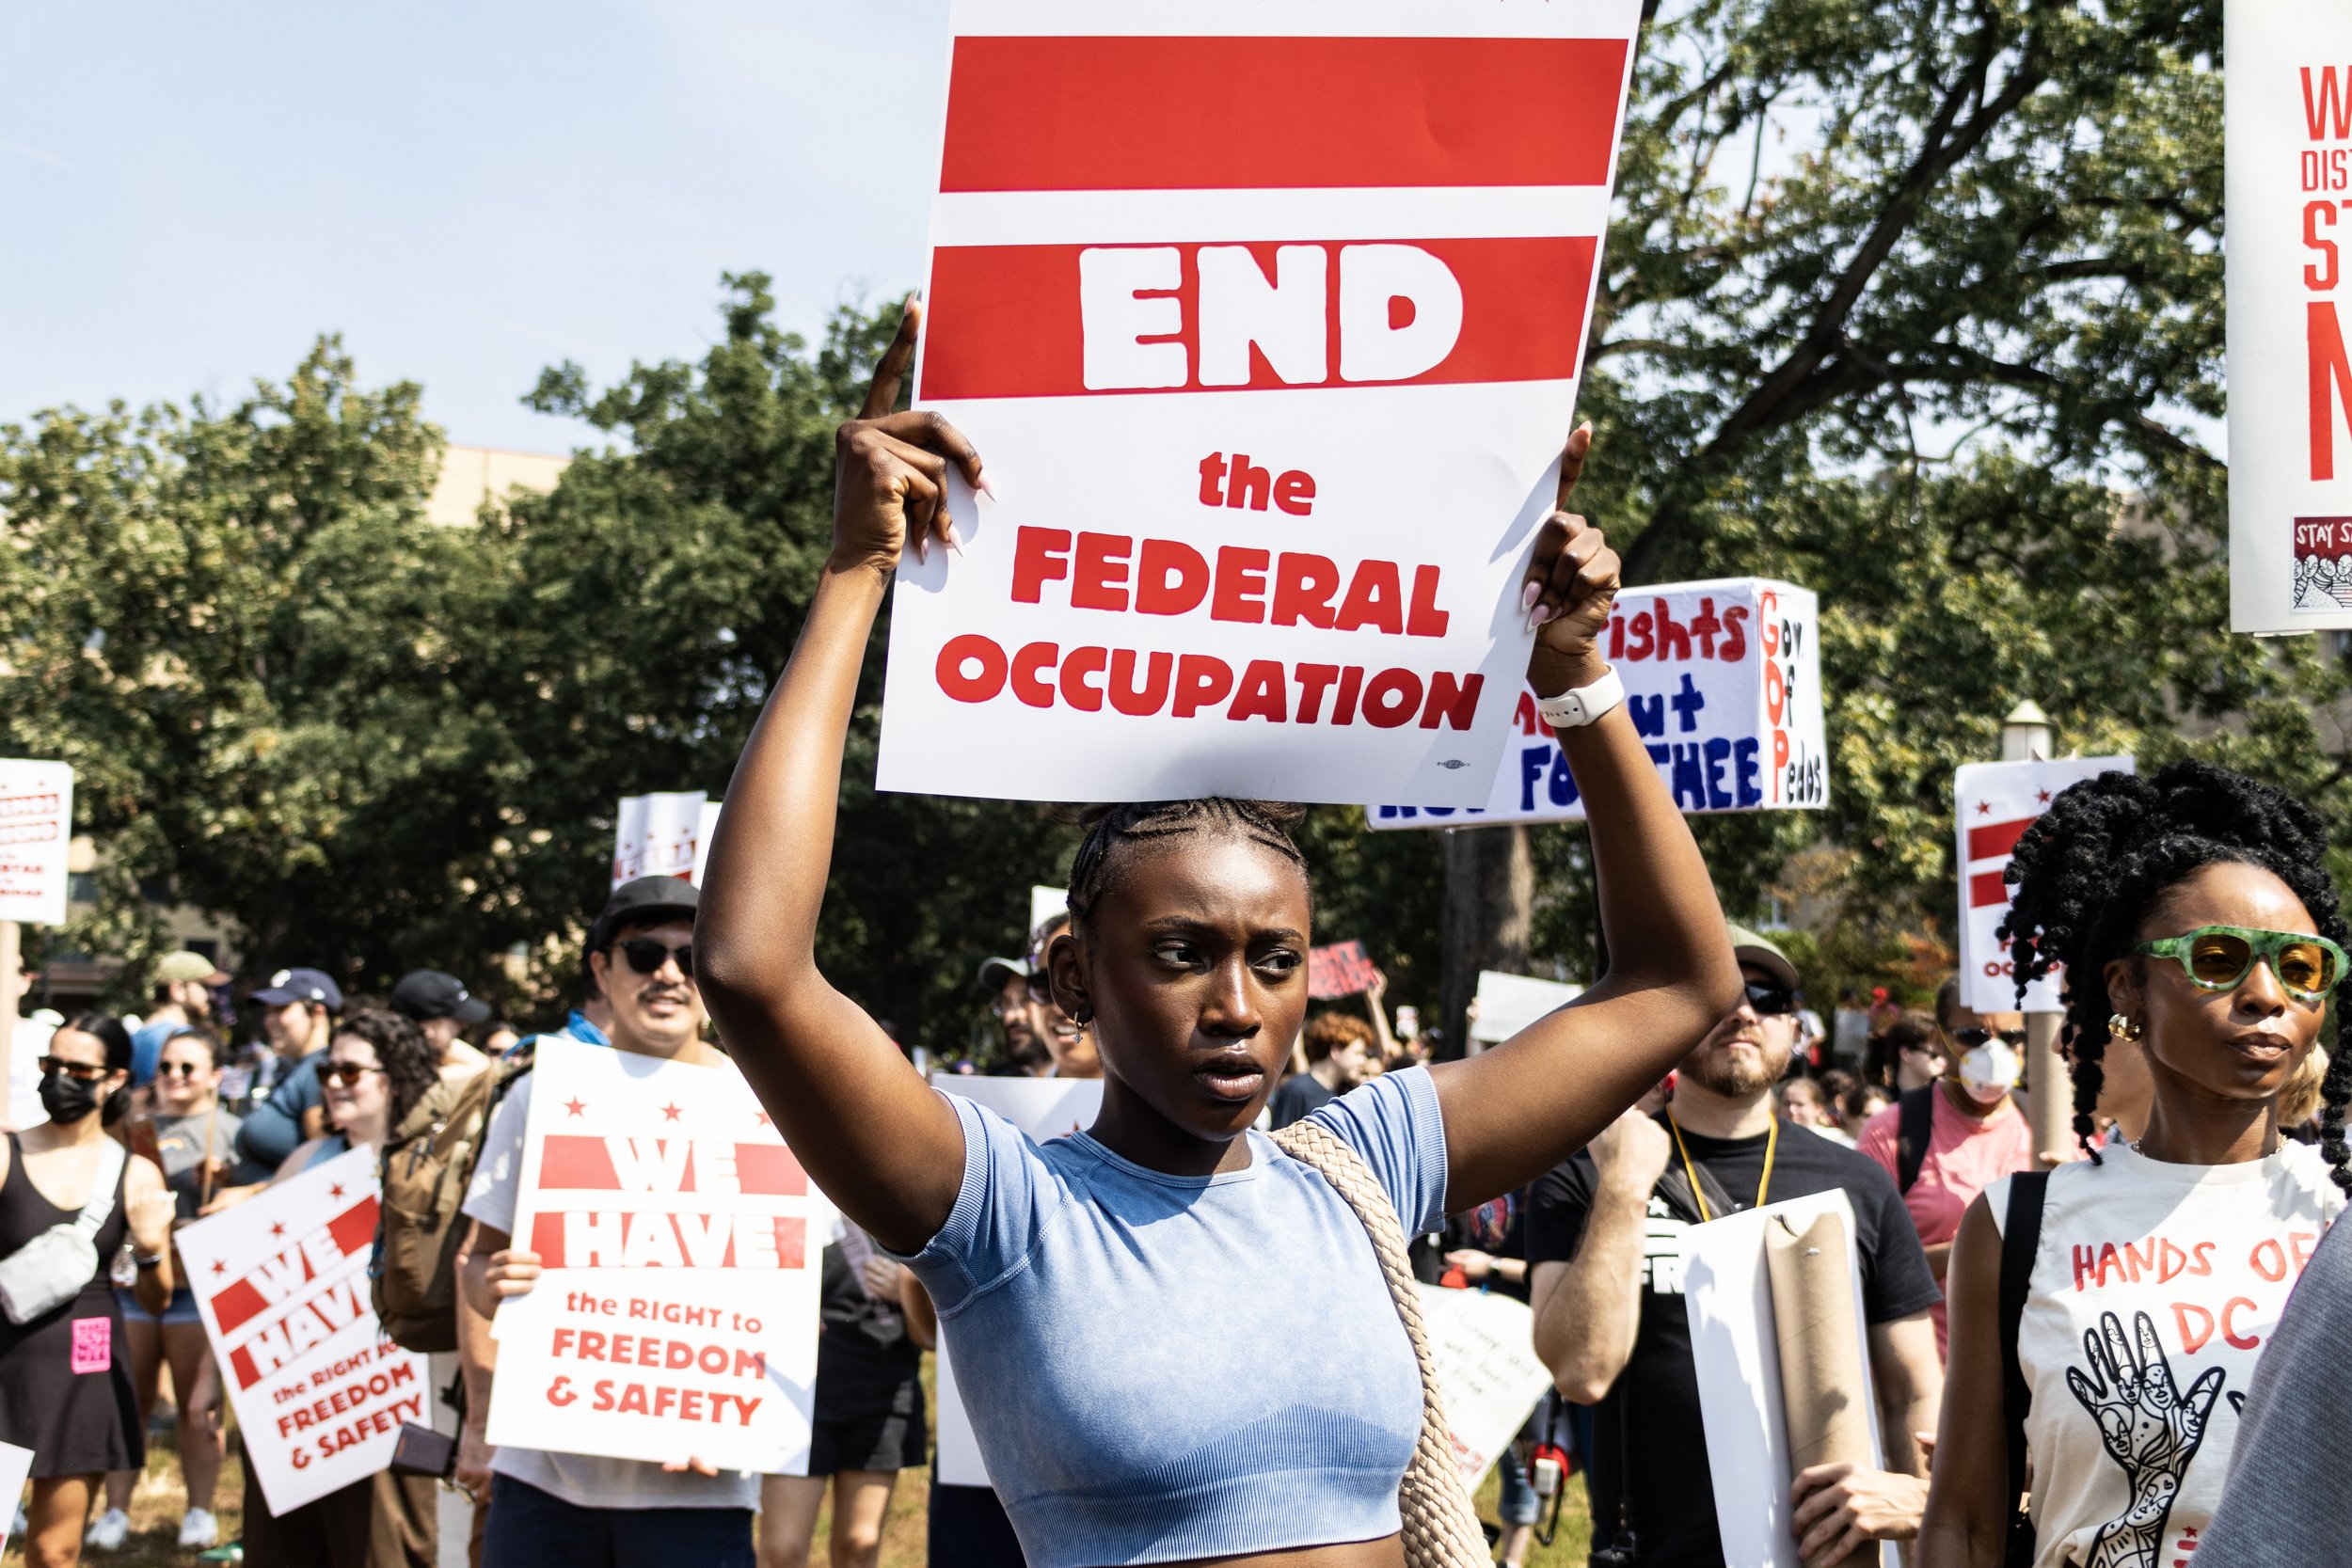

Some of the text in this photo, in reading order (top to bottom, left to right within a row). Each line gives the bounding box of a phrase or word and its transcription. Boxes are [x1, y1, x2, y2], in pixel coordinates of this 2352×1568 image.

[1079, 244, 1465, 391] END
[1200, 451, 1316, 516] the
[2296, 524, 2334, 548] STAY
[1011, 526, 1450, 638] FEDERAL
[936, 630, 1484, 730] OCCUPATION
[1520, 743, 1580, 812] FO
[604, 1136, 741, 1193] WE
[246, 1227, 343, 1301] WE
[563, 1211, 780, 1269] HAVE
[2073, 1232, 2317, 1293] HANDS OF
[566, 1291, 763, 1335] the RIGHT to
[273, 1381, 307, 1404] the
[311, 1349, 373, 1387] RIGHT
[551, 1328, 767, 1381] FREEDOM
[277, 1360, 417, 1439] FREEDOM
[546, 1375, 764, 1427] & SAFETY
[291, 1447, 312, 1471] &
[317, 1392, 423, 1460] SAFETY
